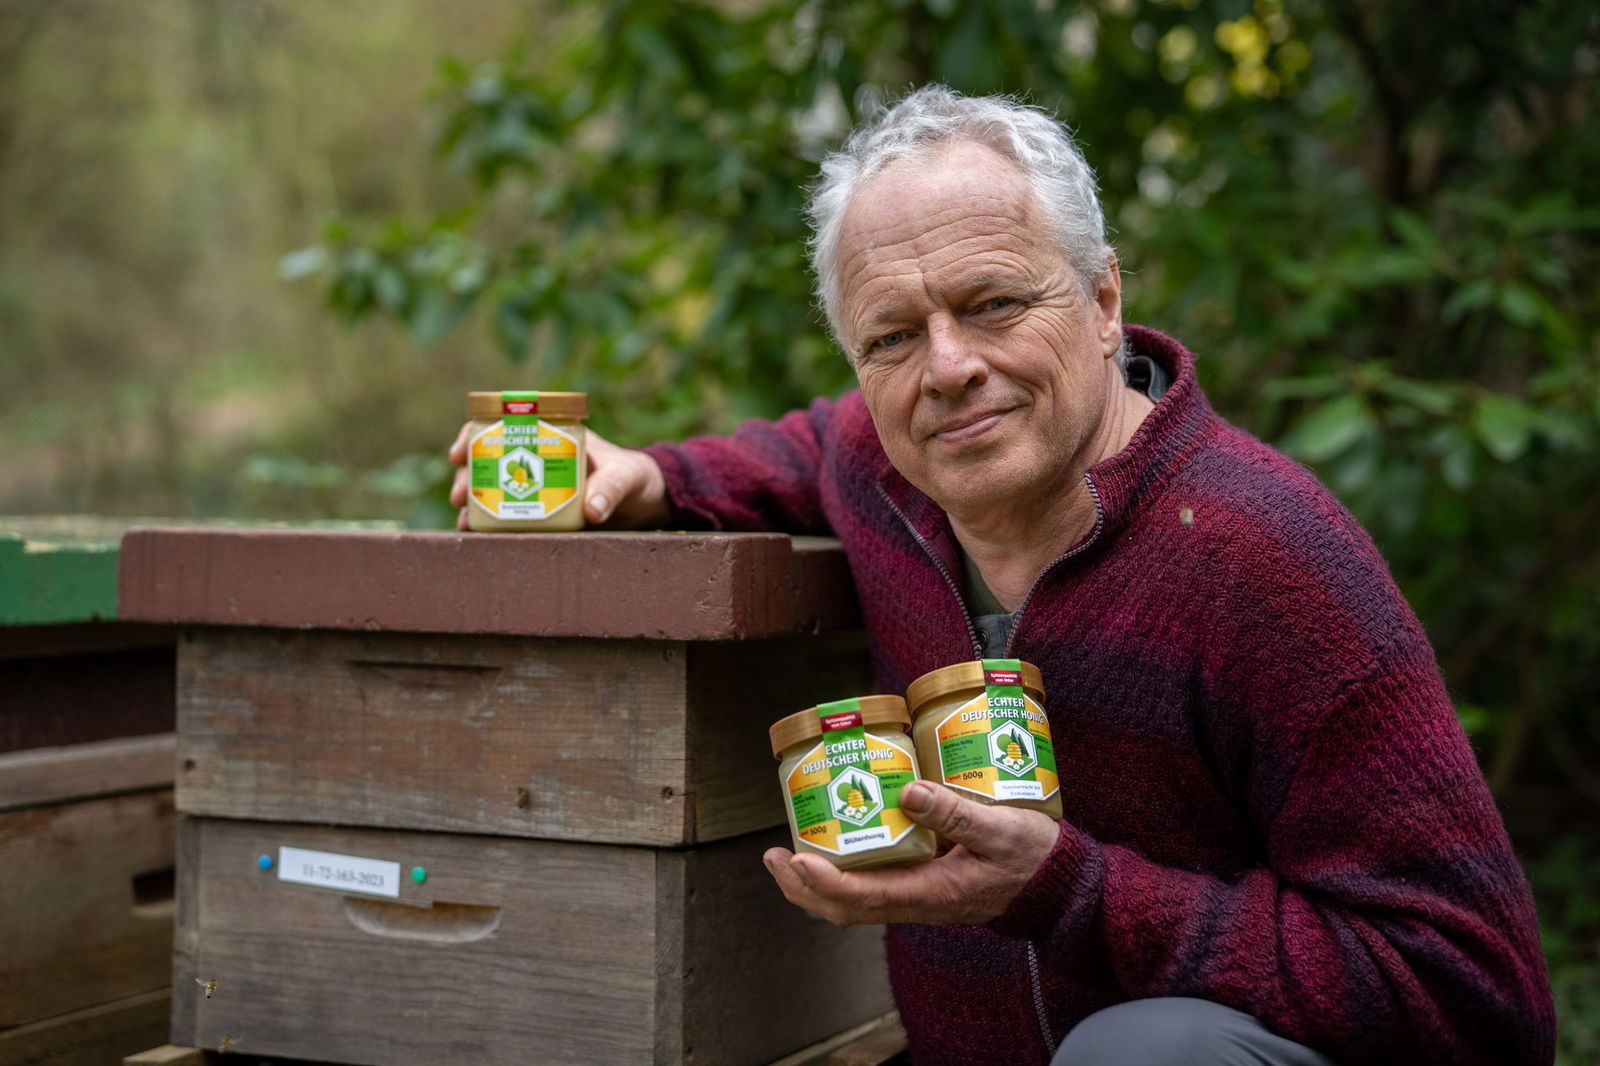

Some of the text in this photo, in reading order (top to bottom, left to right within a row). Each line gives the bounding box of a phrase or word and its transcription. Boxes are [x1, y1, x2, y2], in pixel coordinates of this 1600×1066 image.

[988, 697, 1025, 708] ECHTER
[961, 708, 1044, 725] DEUTSCHER HONIG
[825, 739, 867, 755] ECHTER
[802, 748, 894, 775] DEUTSCHER HONIG
[962, 771, 983, 781] 500g
[809, 825, 827, 836] 500g
[843, 833, 885, 845] Blütenhonig
